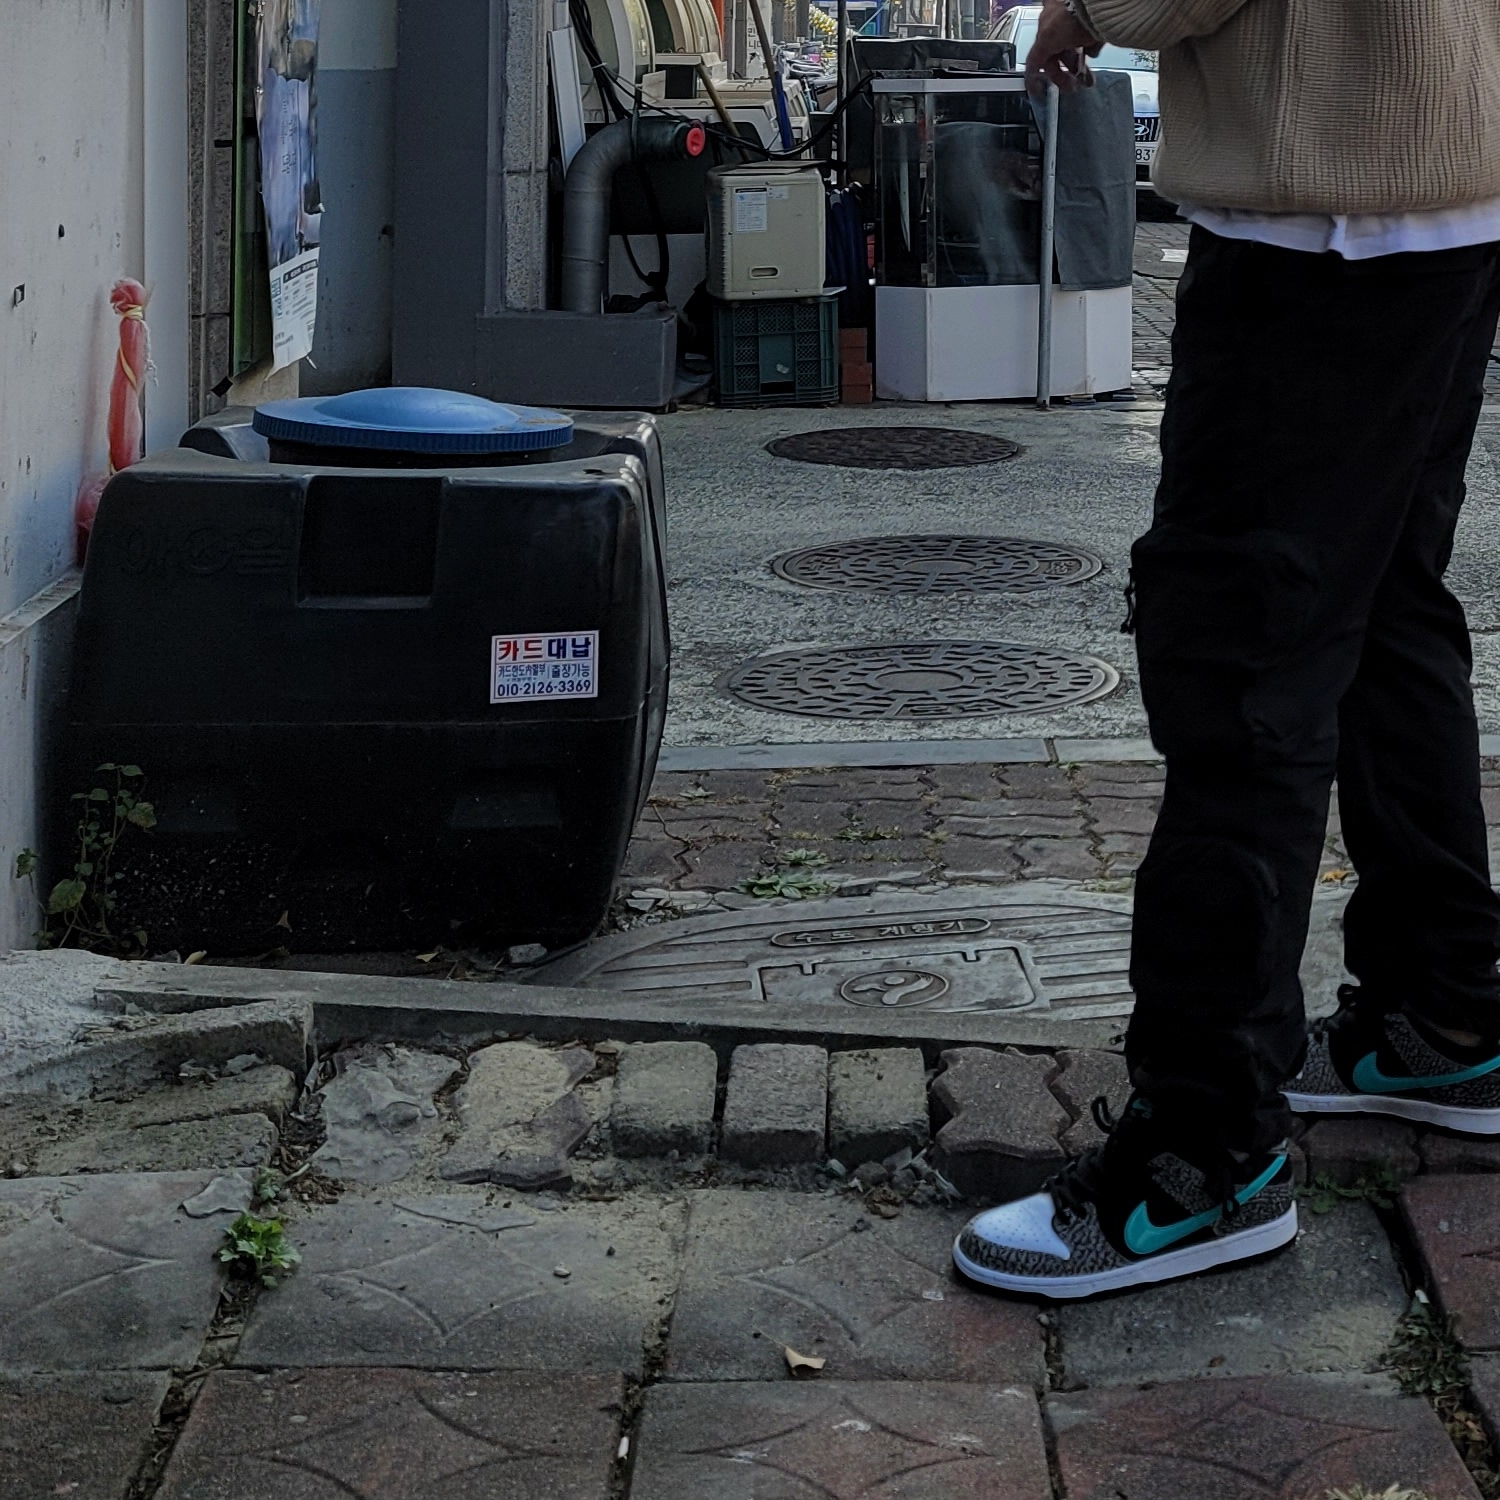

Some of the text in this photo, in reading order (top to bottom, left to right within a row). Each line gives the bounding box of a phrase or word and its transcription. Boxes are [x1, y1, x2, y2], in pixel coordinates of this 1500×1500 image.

[498, 636, 591, 661] 카드대납
[551, 663, 590, 679] 출장가능
[497, 679, 591, 696] 010-2126-3369
[794, 920, 965, 943] 수도 계량기
